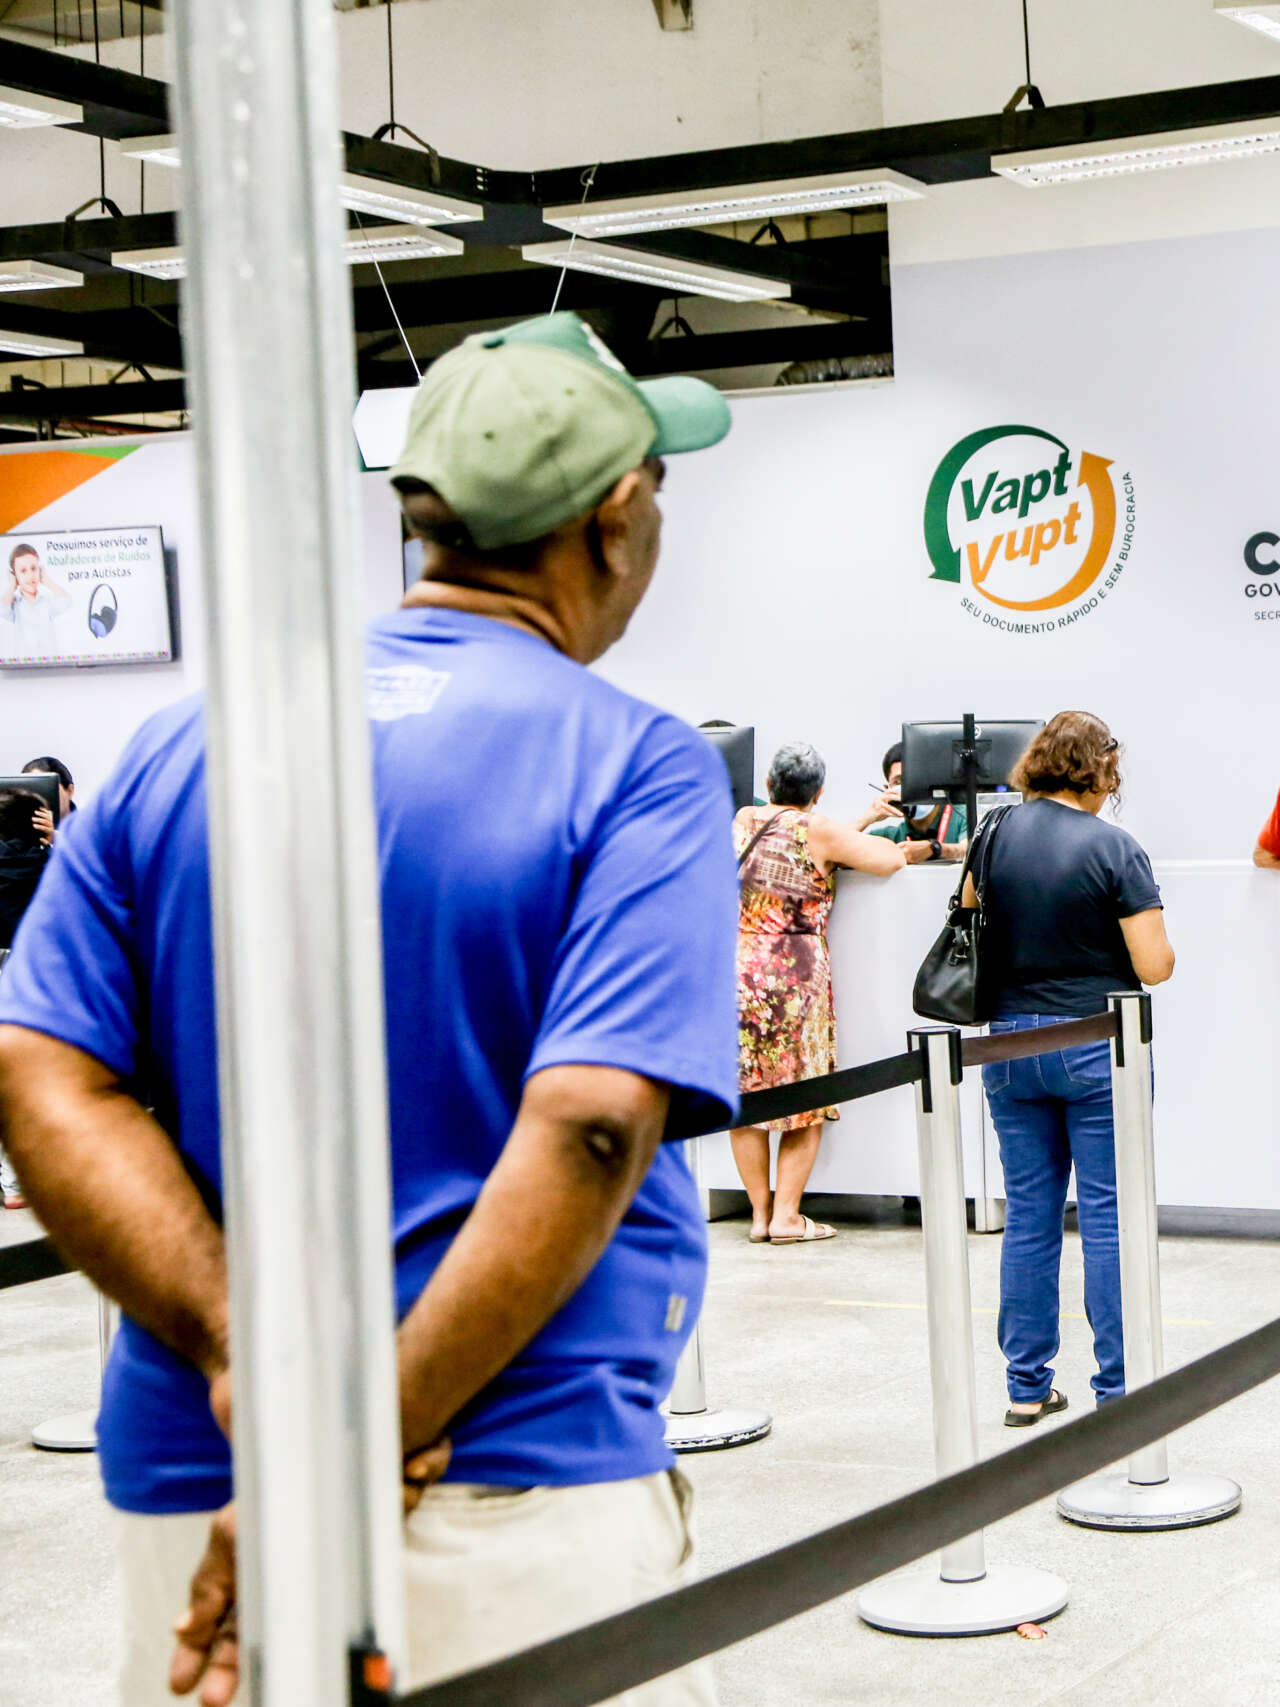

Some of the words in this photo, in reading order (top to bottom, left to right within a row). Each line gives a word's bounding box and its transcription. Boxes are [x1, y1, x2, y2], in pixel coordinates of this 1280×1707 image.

[961, 450, 1072, 522] Vapt
[47, 554, 102, 566] Abafadores
[104, 553, 116, 563] de
[99, 536, 134, 549] serviço
[136, 535, 148, 546] de
[961, 598, 982, 618] SEU
[983, 614, 1055, 634] DOCUMENTO
[1098, 590, 1107, 599] E
[1105, 564, 1124, 589] SEM
[1119, 471, 1136, 561] BUROCRACIA
[966, 501, 1081, 585] Vupt
[68, 571, 90, 582] para
[92, 568, 132, 579] Autistas
